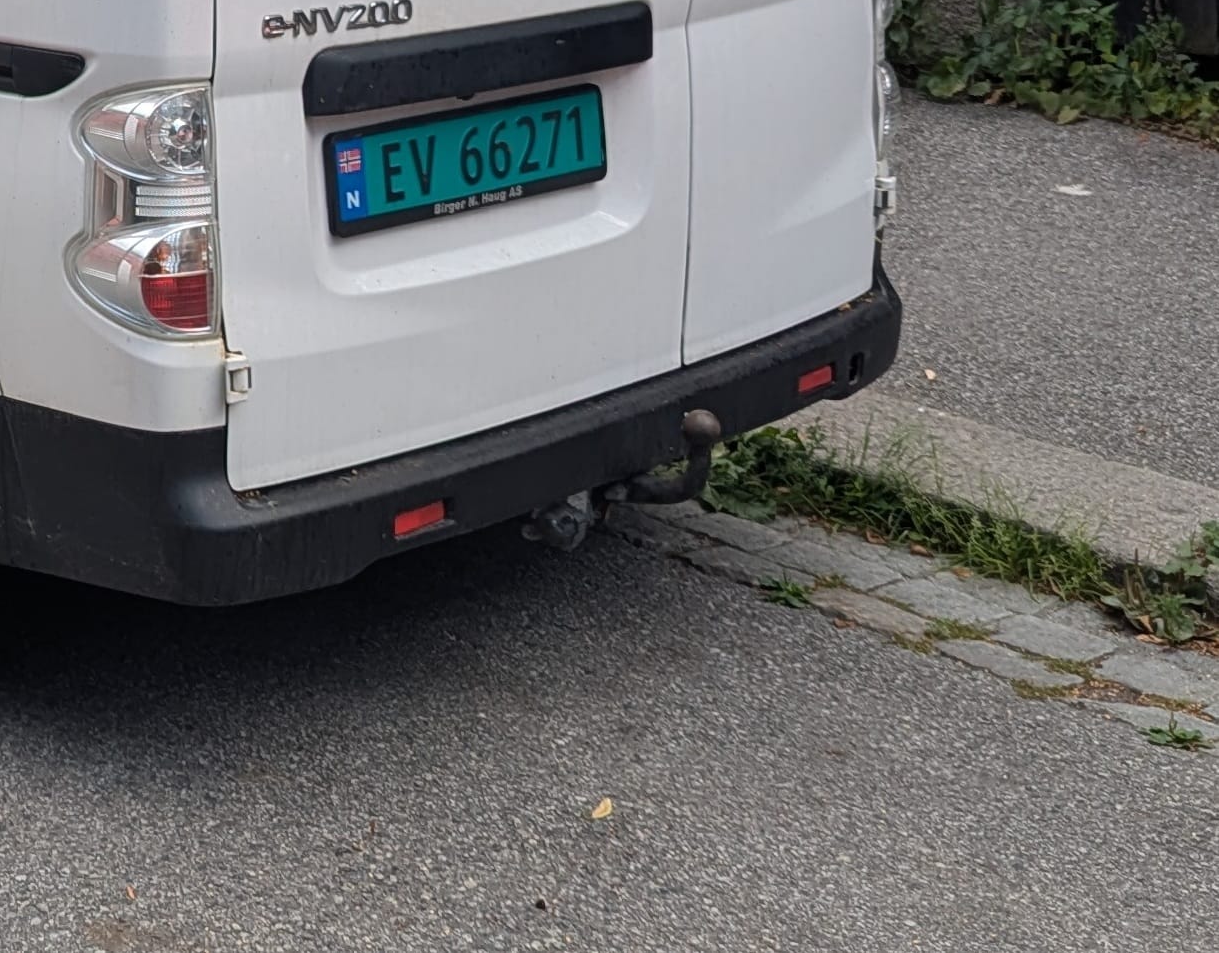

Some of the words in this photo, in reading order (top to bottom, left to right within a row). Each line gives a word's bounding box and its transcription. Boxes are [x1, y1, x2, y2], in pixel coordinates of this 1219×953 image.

[379, 133, 437, 204] EV
[459, 104, 584, 187] 66271
[346, 190, 360, 209] N
[434, 200, 466, 215] Birger
[481, 190, 507, 205] Haug
[508, 185, 523, 198] AS
